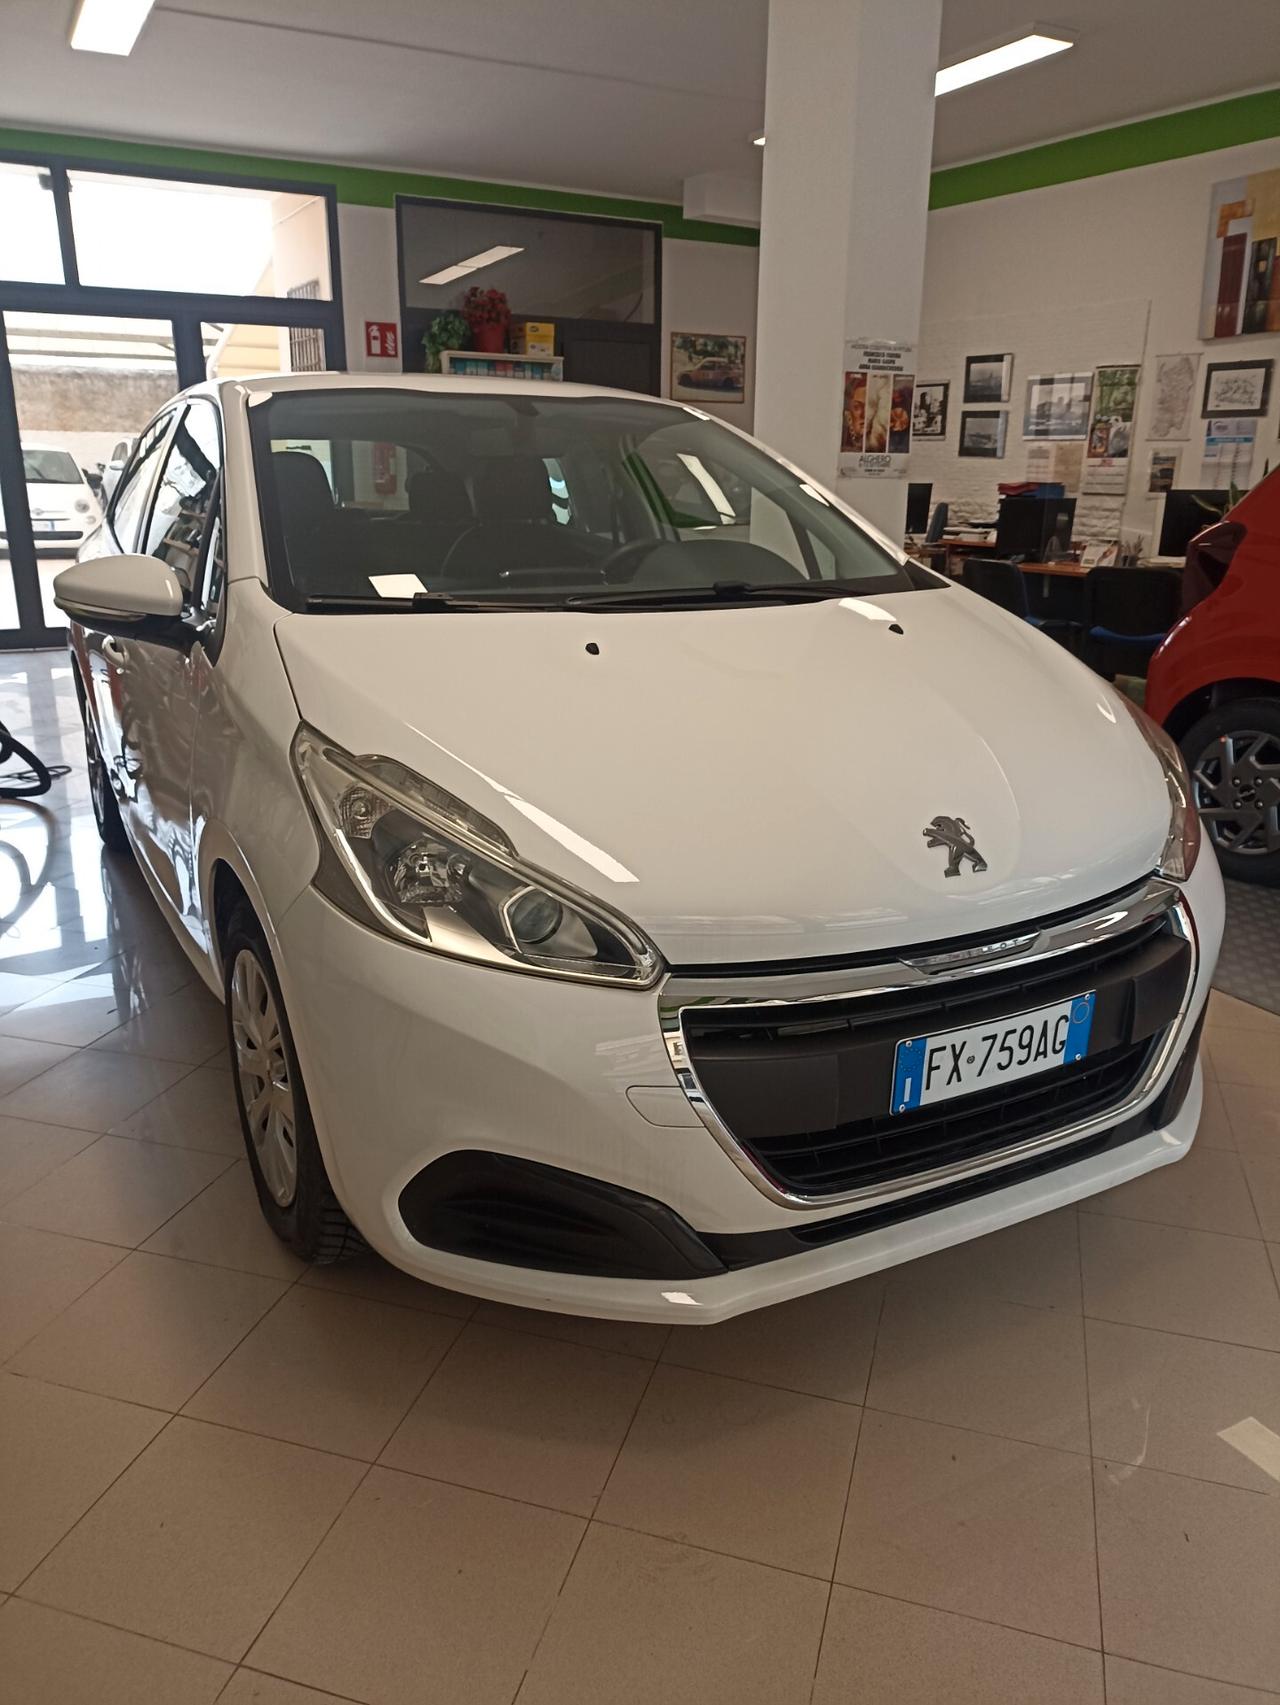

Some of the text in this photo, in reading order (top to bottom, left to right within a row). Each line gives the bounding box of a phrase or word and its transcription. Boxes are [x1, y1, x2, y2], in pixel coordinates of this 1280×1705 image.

[859, 455, 892, 463] ALGHERO
[925, 1014, 1070, 1091] FX 759AG
